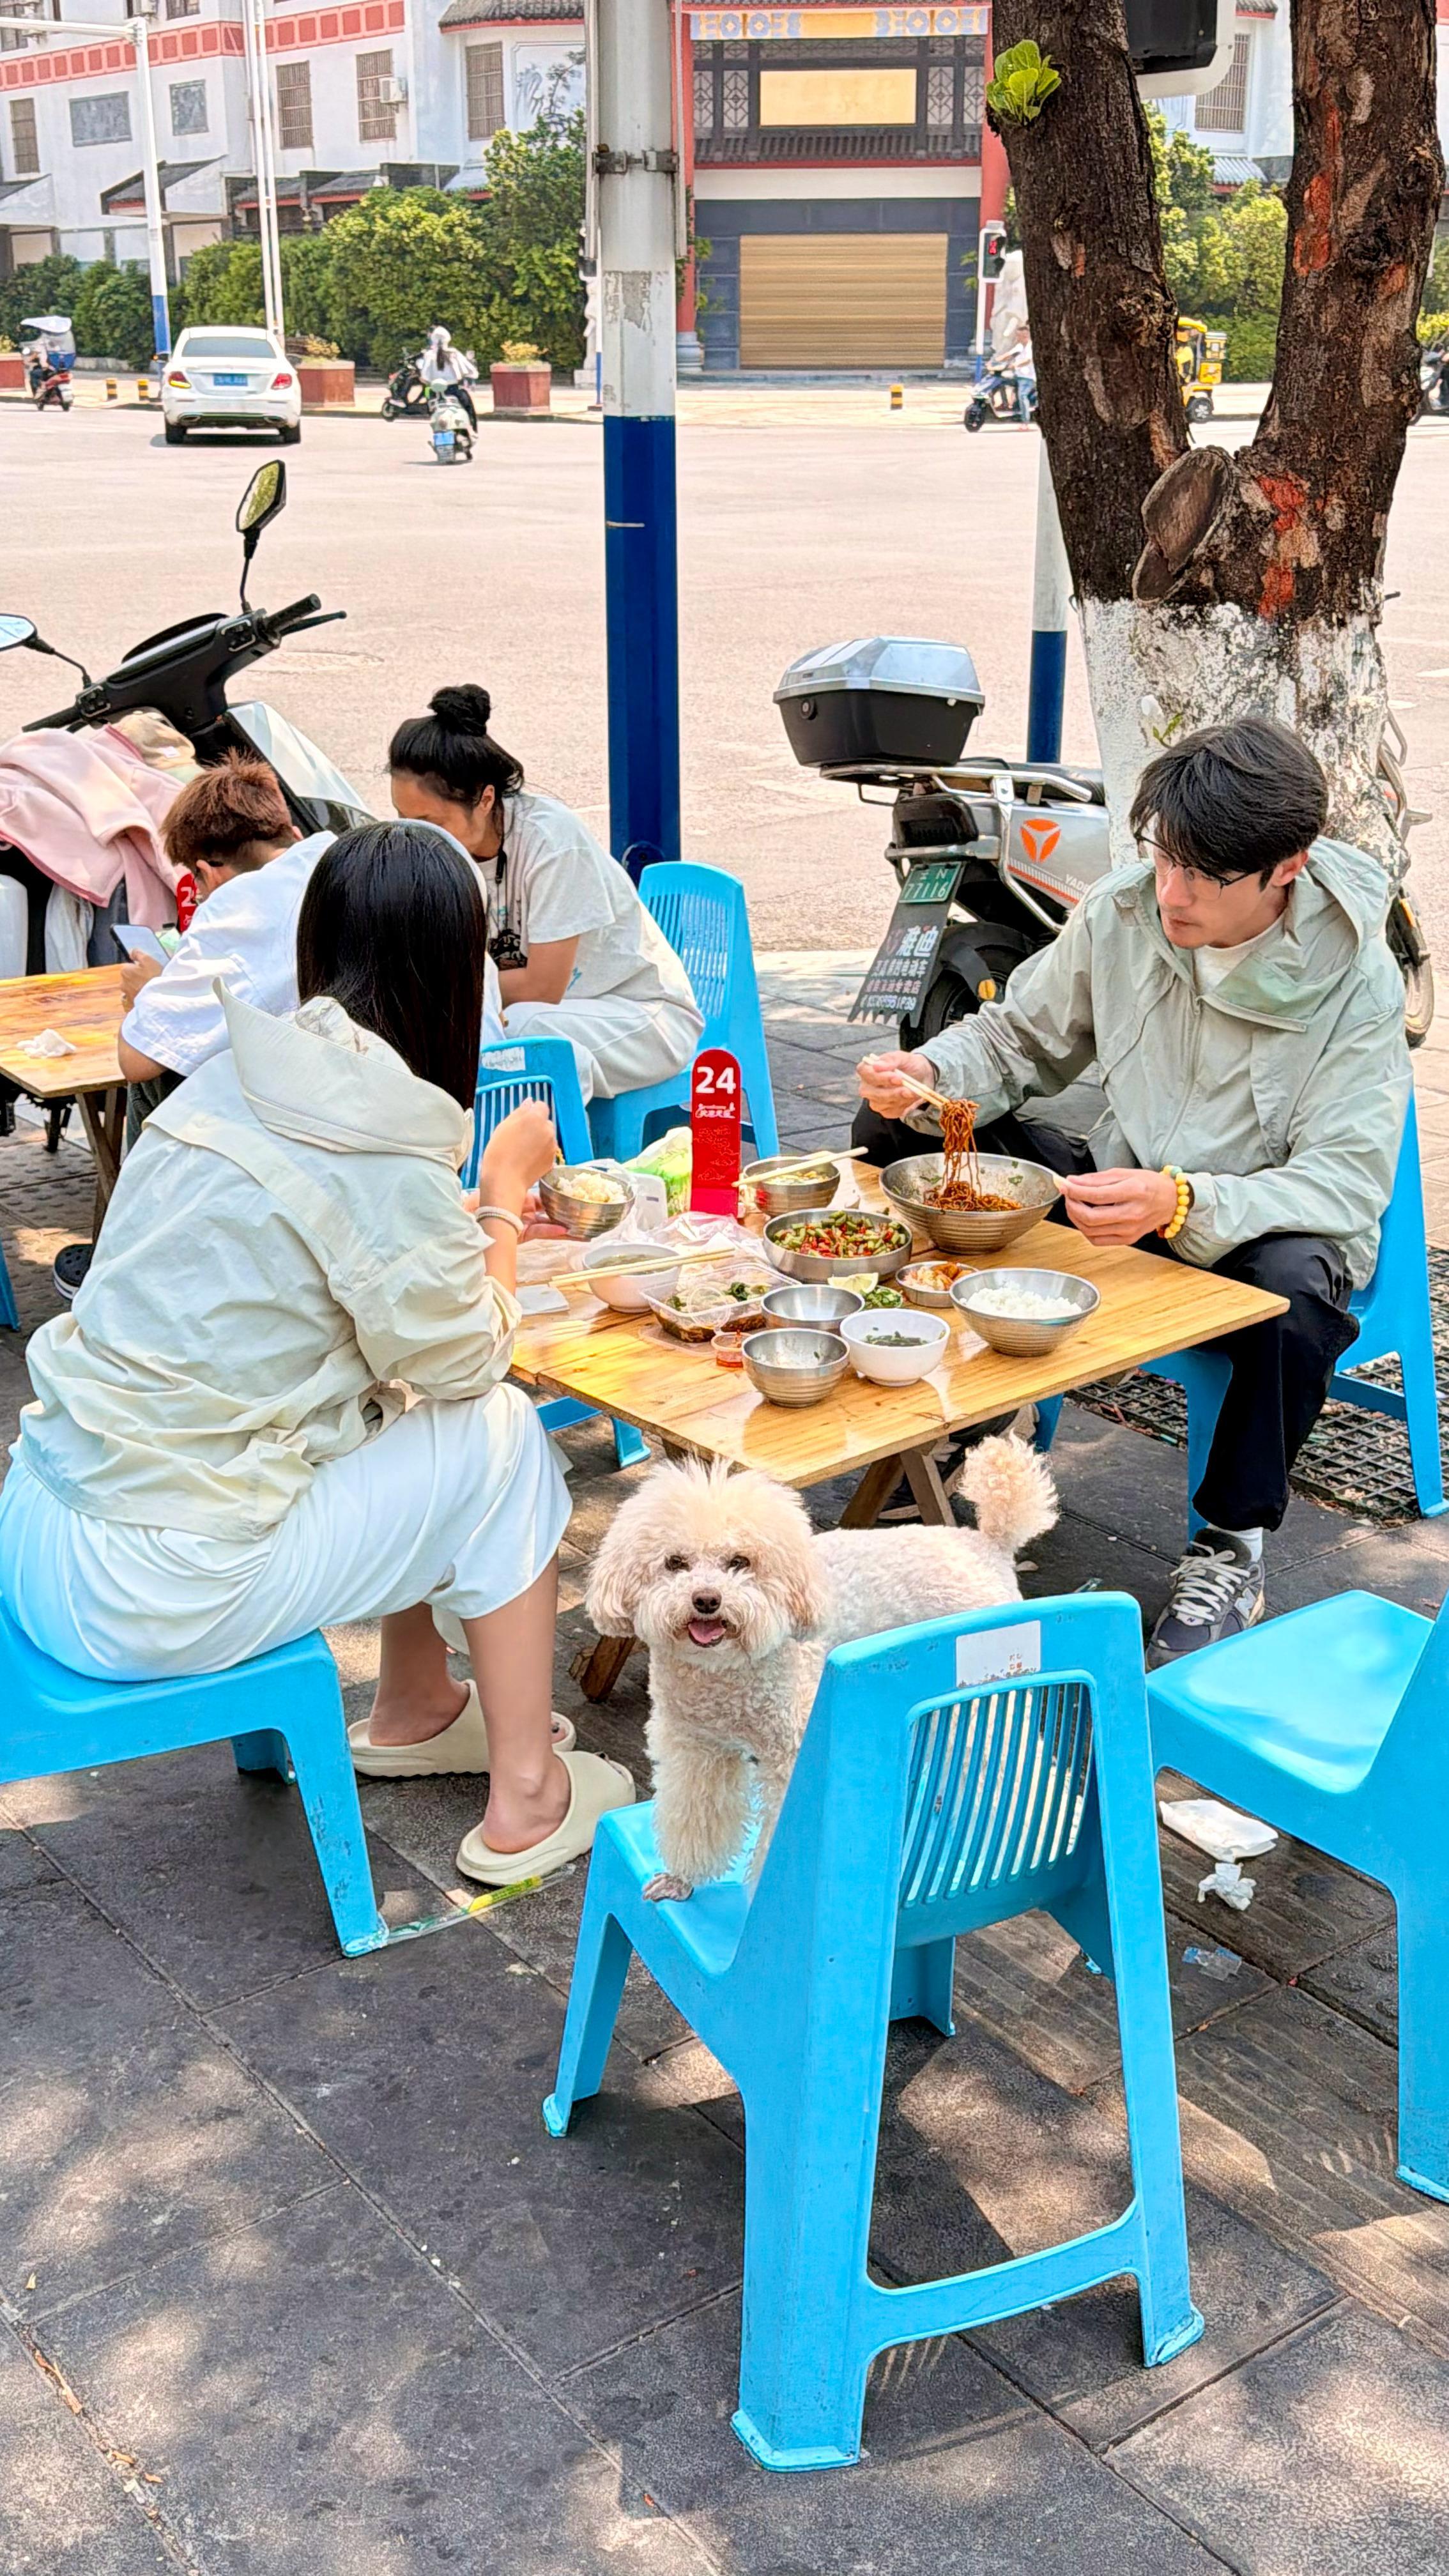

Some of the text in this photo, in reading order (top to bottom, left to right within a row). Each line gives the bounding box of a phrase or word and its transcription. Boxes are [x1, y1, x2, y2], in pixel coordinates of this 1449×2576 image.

[935, 868, 949, 880] N
[904, 881, 949, 900] 77116
[896, 924, 939, 958] 雅迪
[696, 1066, 737, 1094] 24
